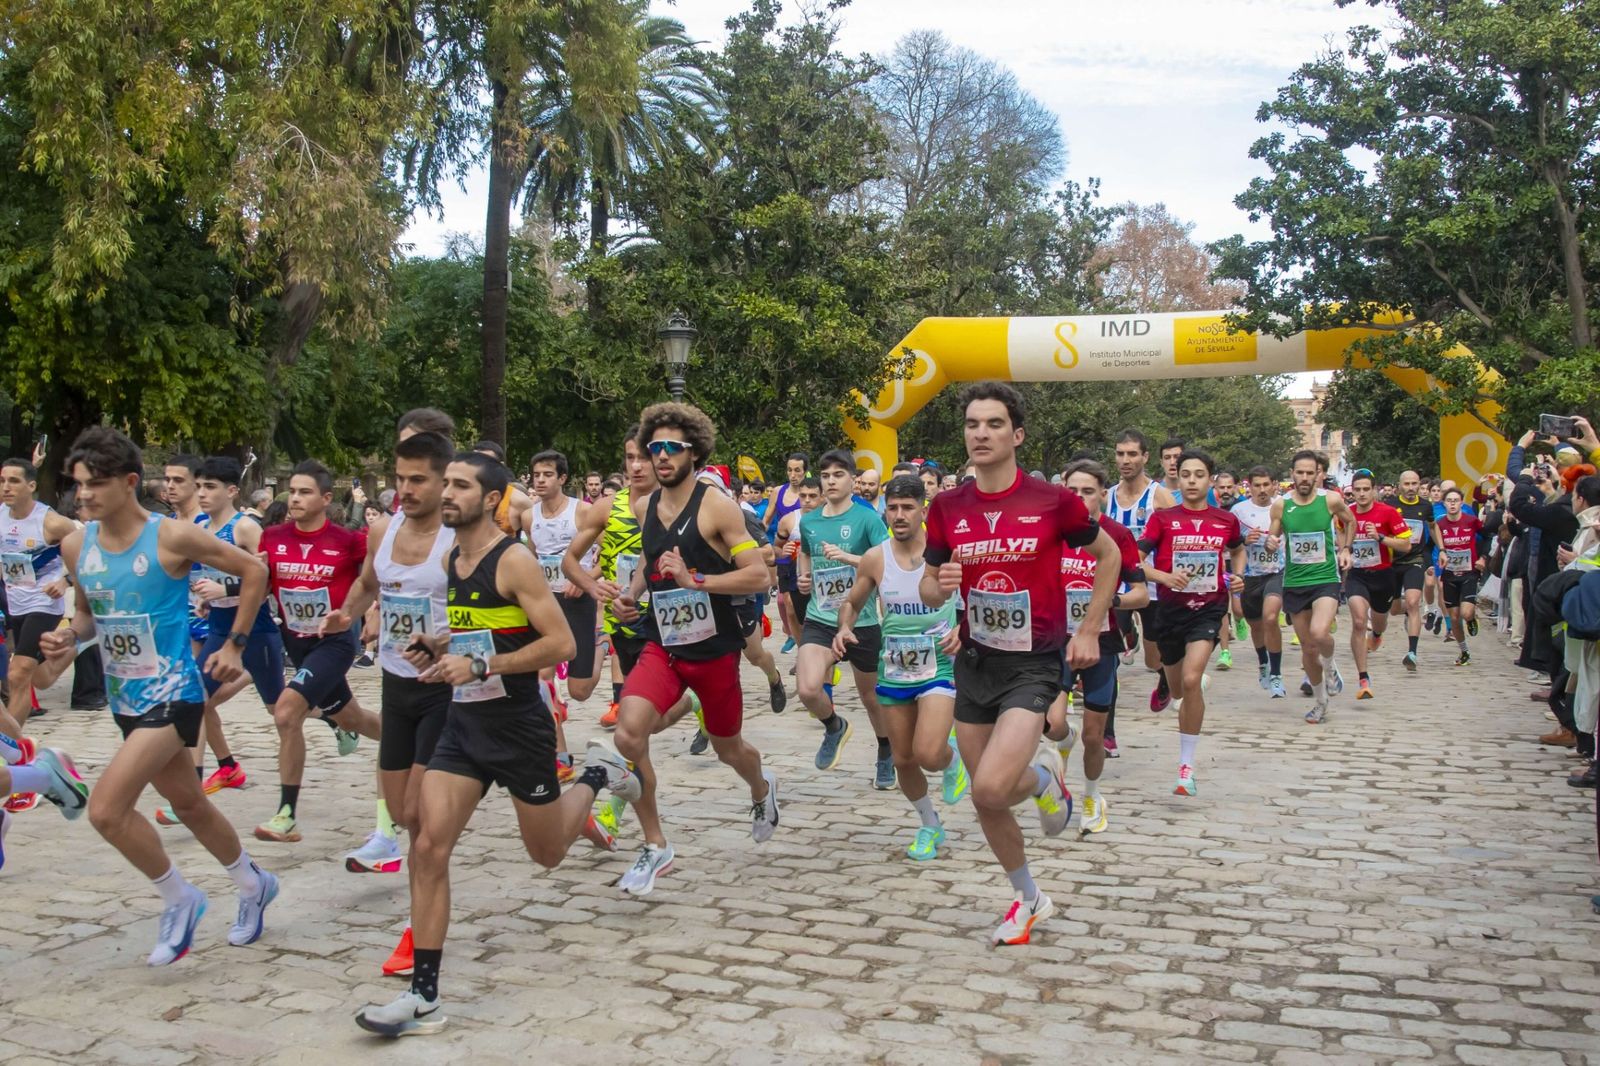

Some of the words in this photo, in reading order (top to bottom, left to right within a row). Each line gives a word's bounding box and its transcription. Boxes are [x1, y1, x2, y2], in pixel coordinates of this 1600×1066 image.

[1101, 320, 1150, 337] IMD
[1089, 350, 1122, 359] Instituto
[1123, 349, 1162, 359] Municipal
[1207, 345, 1235, 353] SEVILLA
[1102, 360, 1112, 368] de
[1114, 359, 1150, 369] Deportes
[957, 538, 1039, 557] ISBILYA
[1172, 535, 1224, 546] ISBILYA
[1295, 541, 1319, 553] 294
[817, 576, 854, 597] 1264
[285, 601, 327, 618] 1902
[659, 601, 708, 627] 2230
[969, 604, 1026, 630] 1889
[382, 611, 427, 635] 1291
[103, 633, 142, 657] 498
[888, 648, 931, 669] 1127
